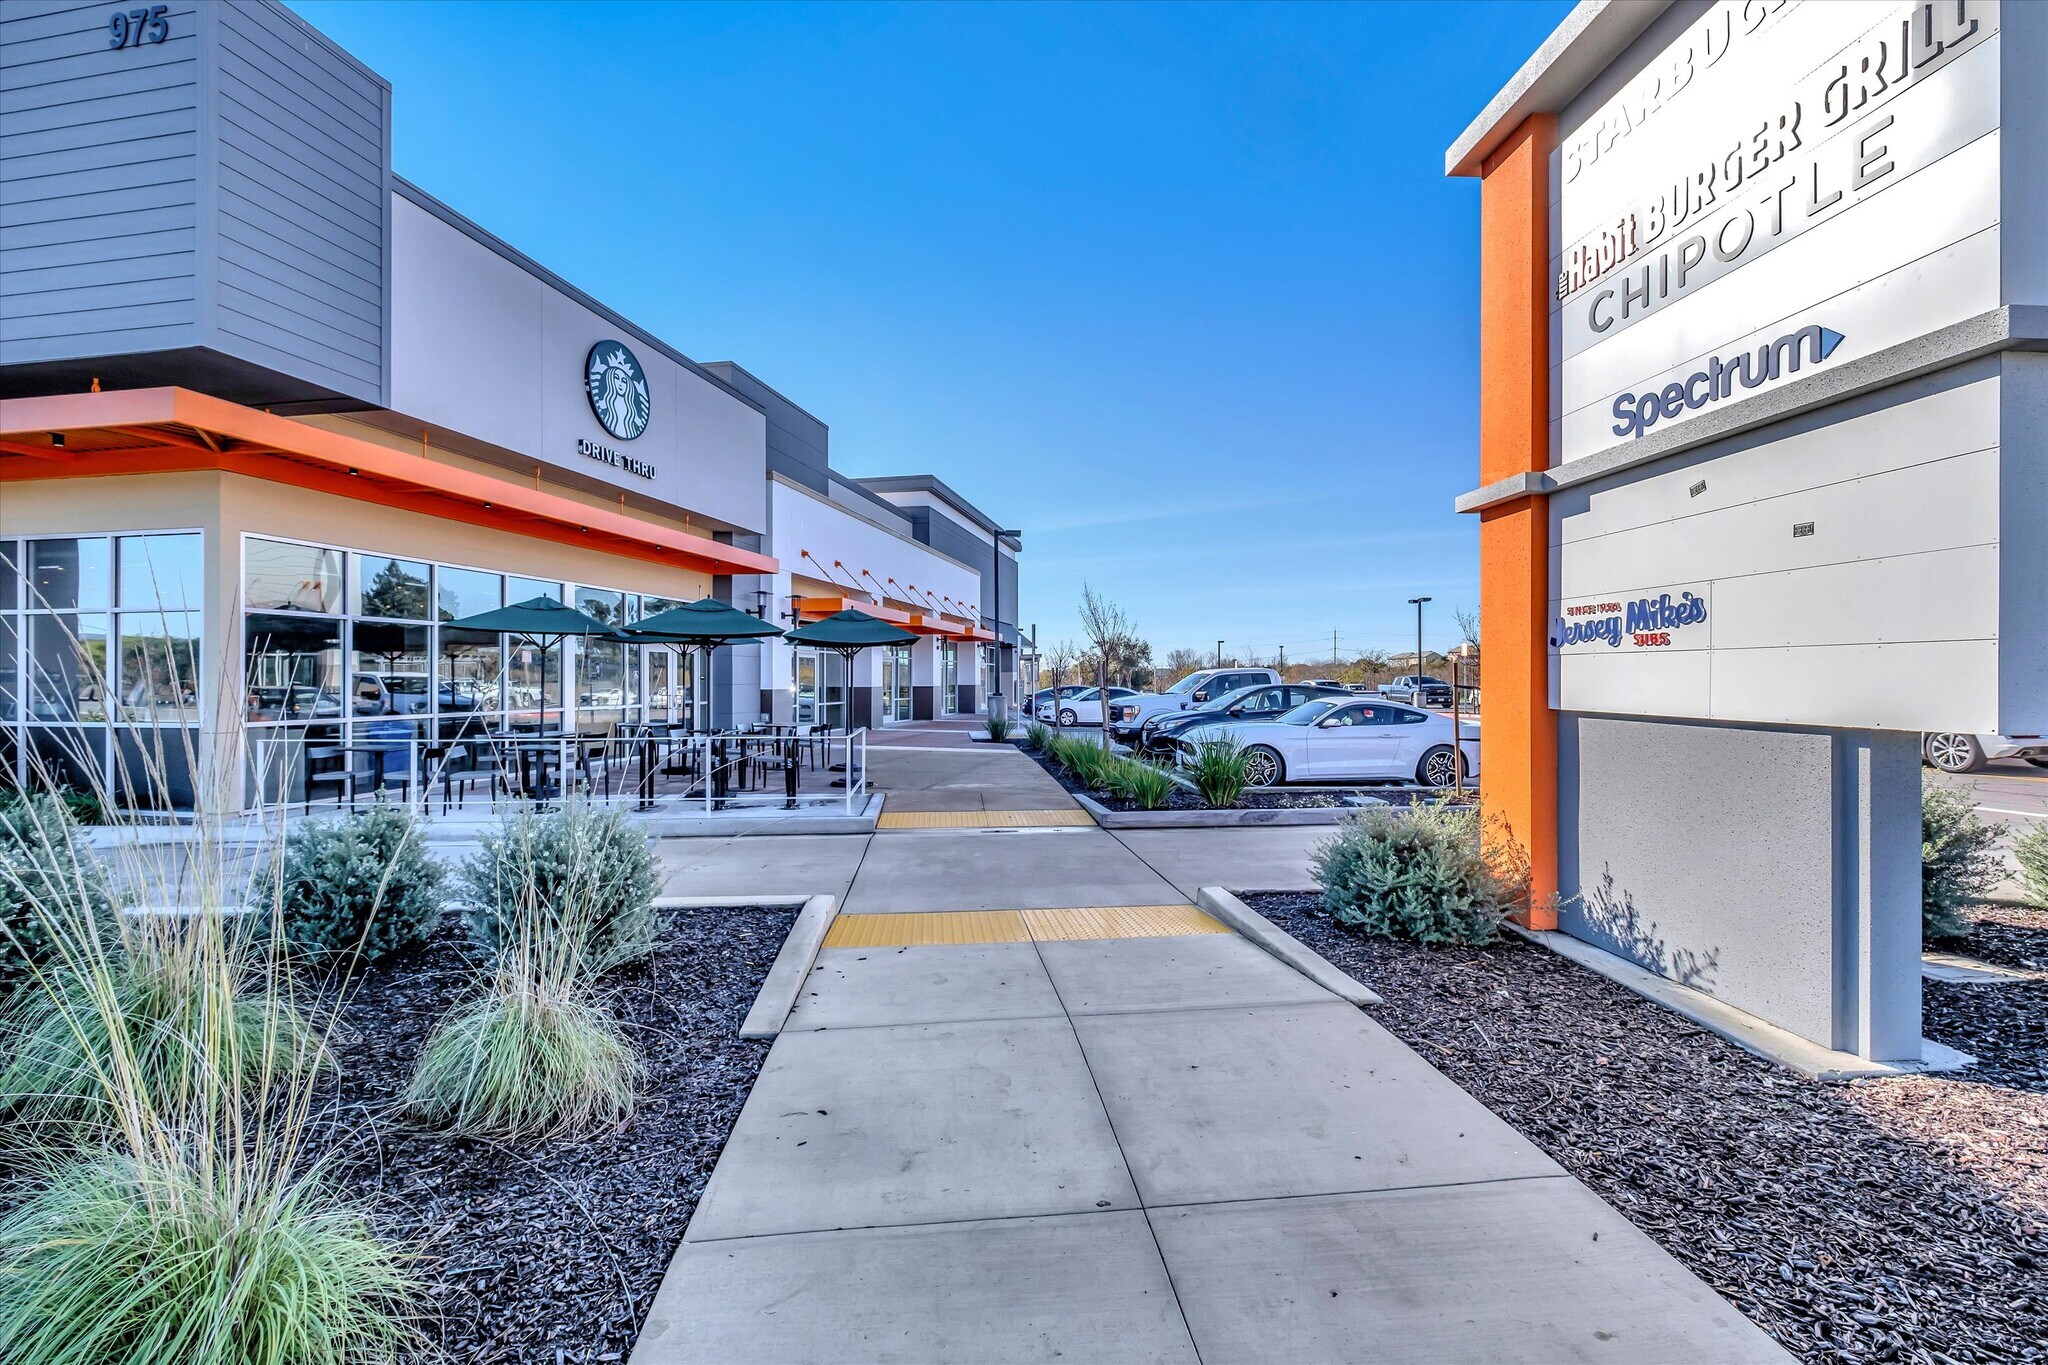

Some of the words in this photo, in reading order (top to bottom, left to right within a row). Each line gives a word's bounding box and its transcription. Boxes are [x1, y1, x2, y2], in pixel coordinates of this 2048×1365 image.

[109, 4, 168, 50] 975
[1565, 0, 1787, 184] STARBUC
[1568, 212, 1636, 294] Habit
[1643, 99, 1802, 244] BURGER
[1823, 0, 1978, 128] GRILL
[1588, 114, 1894, 333] CHIPOTLE
[1612, 324, 1823, 439] Spectrum
[578, 439, 620, 467] DRIVE
[622, 455, 657, 480] THRU
[1550, 616, 1623, 648] Jersey
[1625, 591, 1708, 635] Mike's
[1567, 604, 1597, 616] SINCE
[1597, 601, 1622, 613] 1956
[1633, 632, 1671, 646] SUBS
